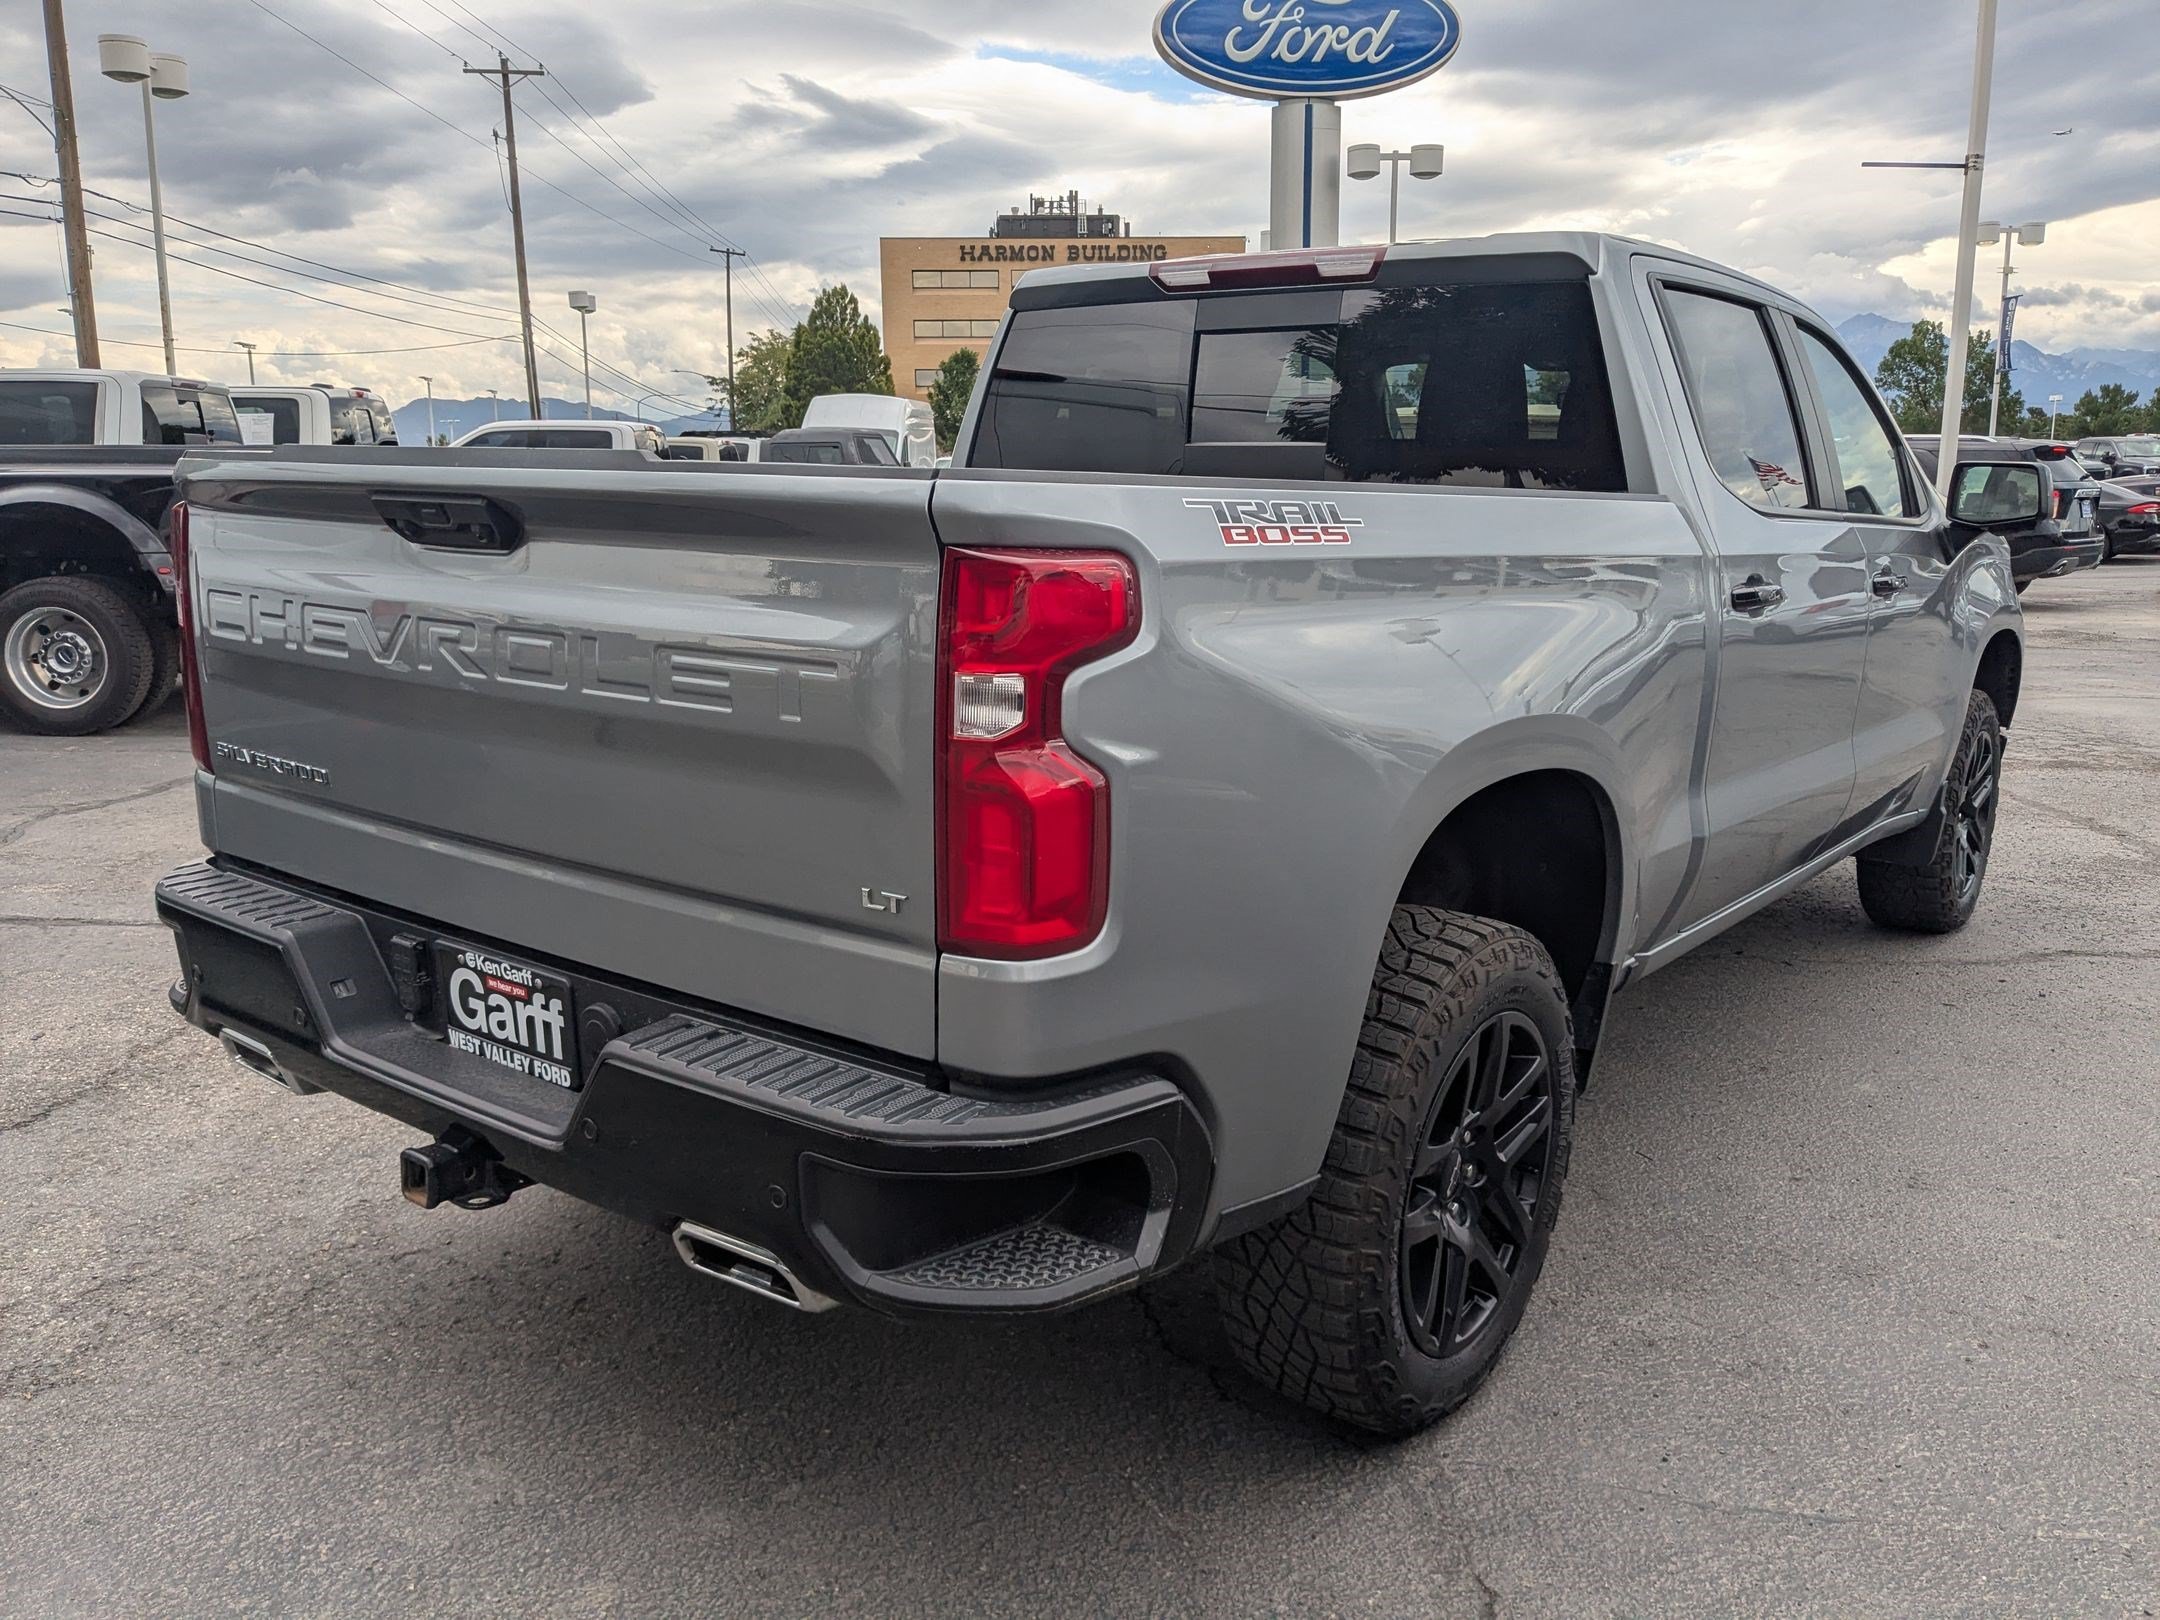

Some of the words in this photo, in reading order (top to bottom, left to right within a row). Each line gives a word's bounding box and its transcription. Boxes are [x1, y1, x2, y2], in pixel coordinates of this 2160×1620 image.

[1223, 0, 1400, 64] Ford
[959, 244, 1055, 262] HARMON
[1067, 244, 1168, 261] BUILDING
[1182, 498, 1364, 527] TRAIL
[1219, 524, 1351, 546] BOSS
[206, 588, 838, 722] CHEVROLET
[216, 741, 330, 785] SILVERADO
[861, 887, 909, 914] LT
[476, 954, 500, 976] Ken
[500, 962, 532, 986] Garff
[488, 978, 497, 988] we
[497, 980, 512, 993] hear
[512, 986, 525, 997] you
[450, 967, 565, 1060] Garff
[448, 1028, 481, 1056] WEST
[482, 1042, 530, 1074] VALLEY
[533, 1060, 571, 1088] FORD
